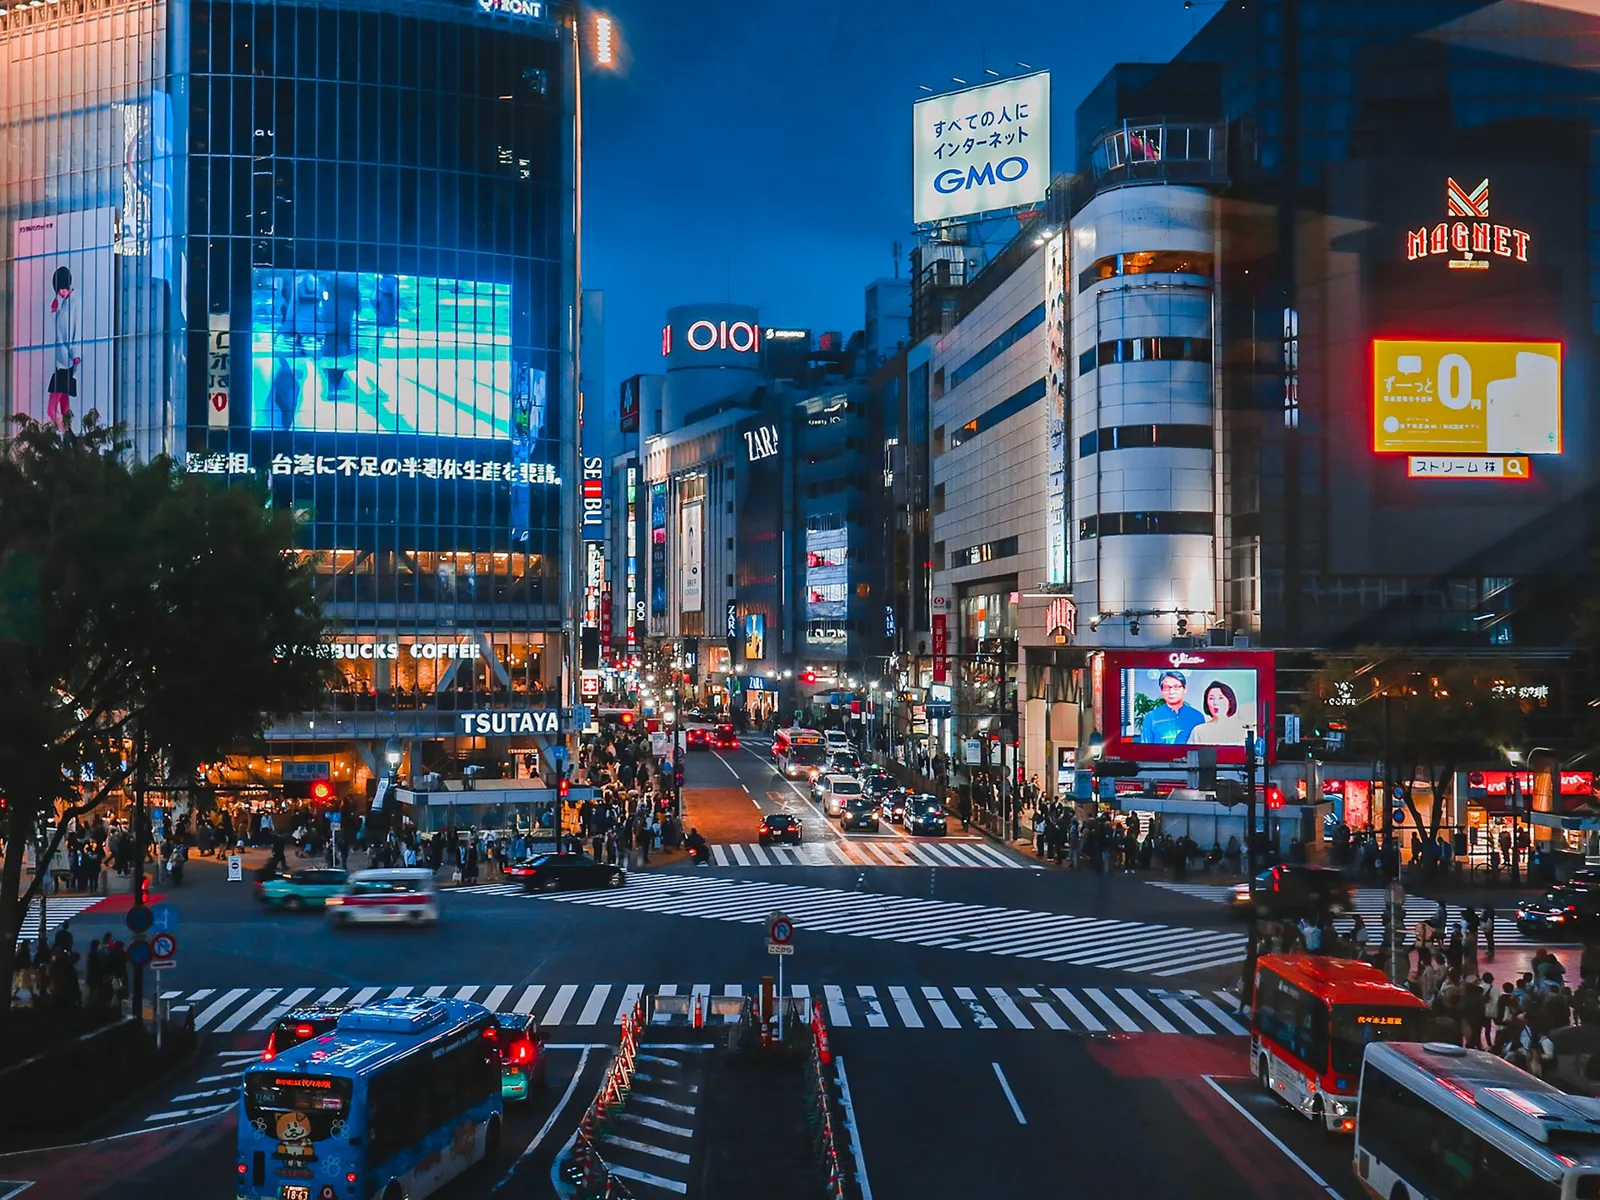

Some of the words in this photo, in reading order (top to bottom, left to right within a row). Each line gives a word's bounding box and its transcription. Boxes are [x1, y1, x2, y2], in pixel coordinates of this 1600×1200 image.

[933, 104, 1029, 138] すべての人に
[933, 126, 1029, 160] インターネット
[933, 156, 1029, 194] GMO
[1407, 221, 1530, 261] MAGNET
[744, 425, 778, 461] ZARA
[1416, 461, 1478, 473] ストリーム
[584, 457, 602, 525] SEIBU
[410, 643, 481, 659] COFFEE
[1169, 652, 1206, 668] Glico
[749, 677, 763, 689] ZARA
[461, 712, 559, 734] TSUTAYA
